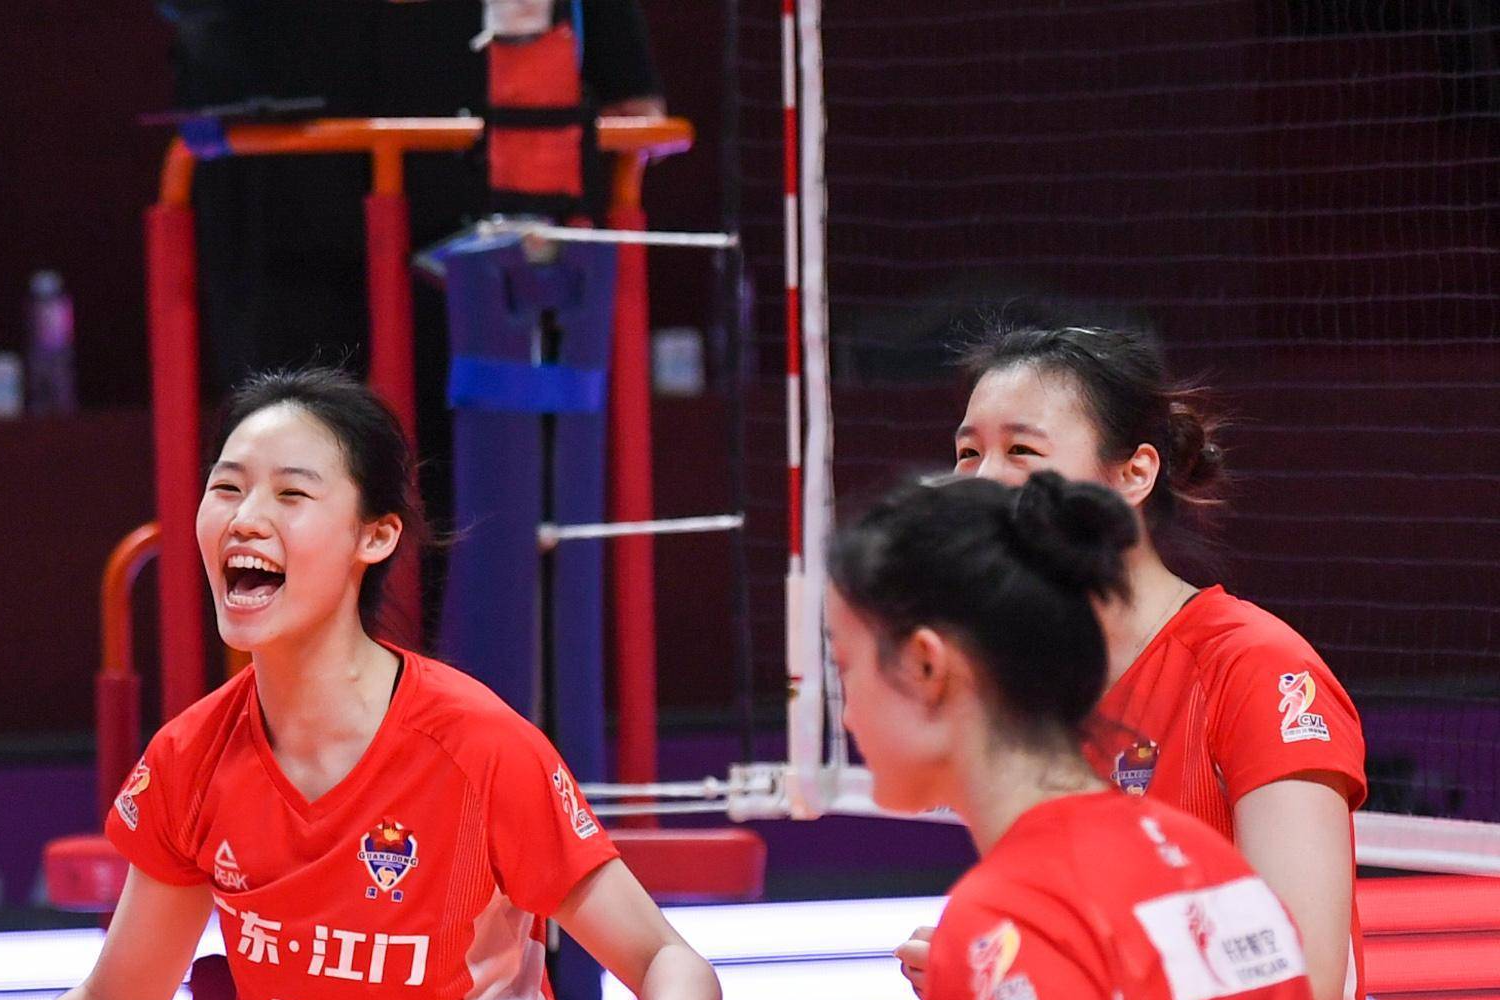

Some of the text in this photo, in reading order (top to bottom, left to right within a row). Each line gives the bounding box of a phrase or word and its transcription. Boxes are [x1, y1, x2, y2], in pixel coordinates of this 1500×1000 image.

[1300, 715, 1325, 727] CVL
[358, 851, 417, 866] GUANGDONG
[213, 893, 430, 986] 东·江门
